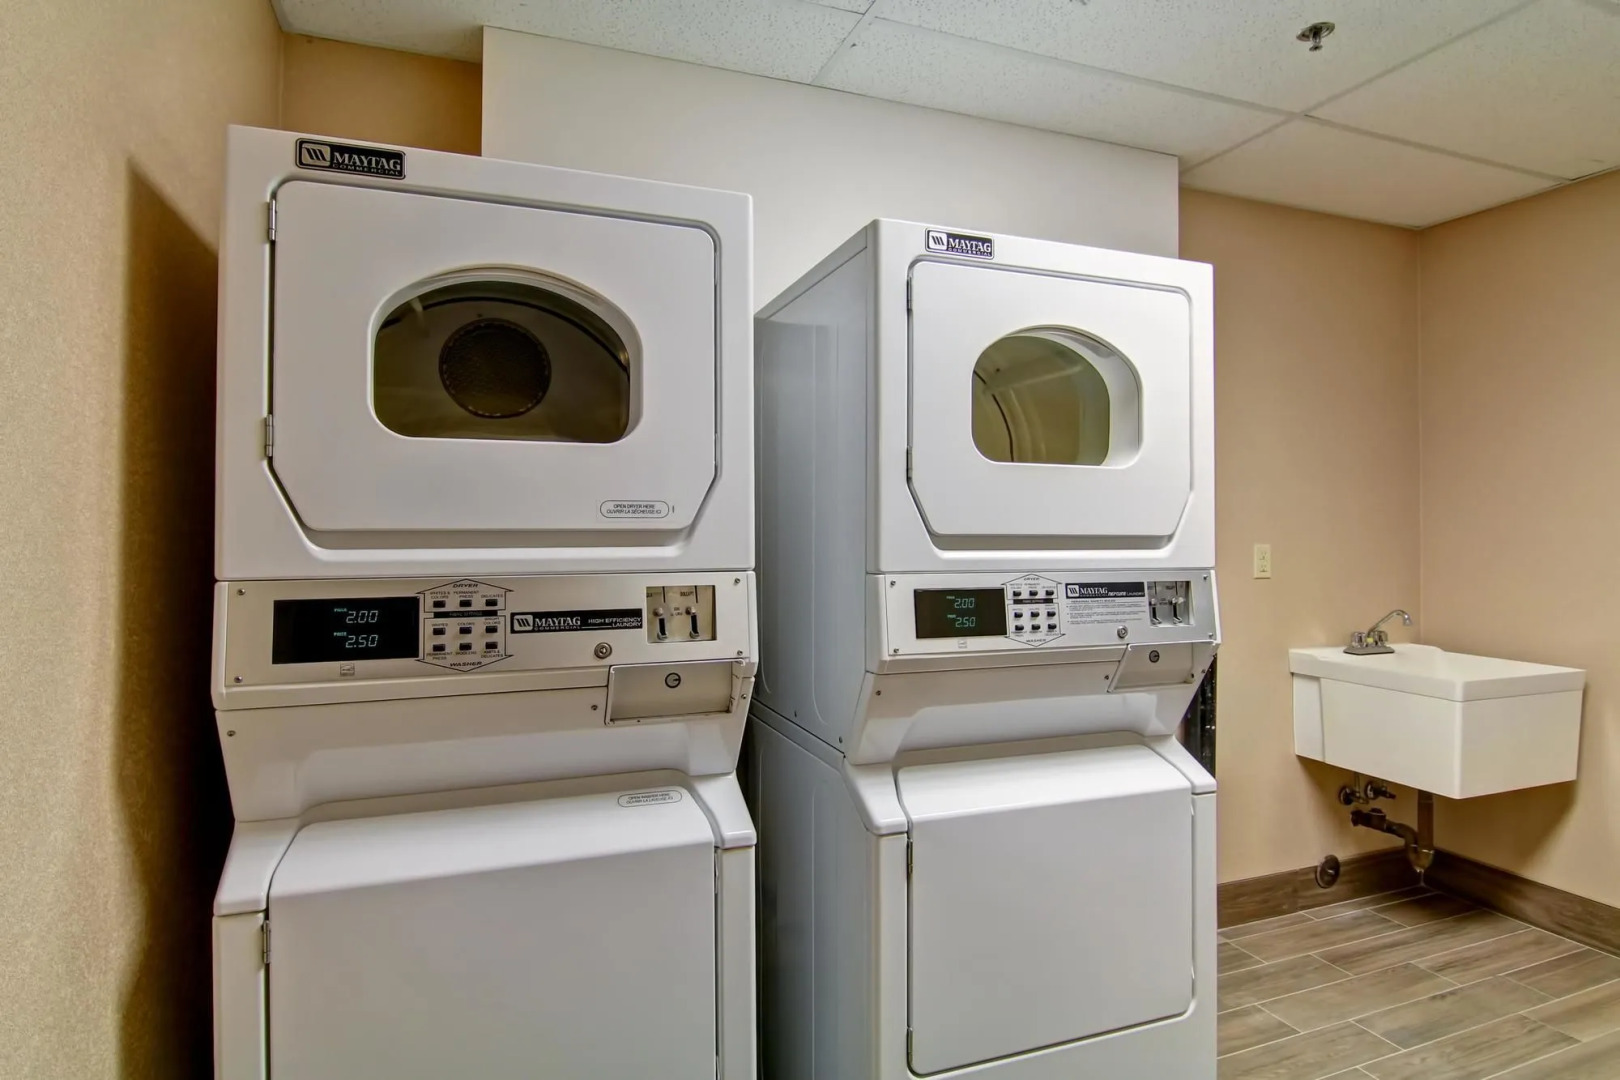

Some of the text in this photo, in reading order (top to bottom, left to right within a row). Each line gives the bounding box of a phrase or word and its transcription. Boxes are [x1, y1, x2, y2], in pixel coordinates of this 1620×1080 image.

[333, 151, 401, 171] MAYTAG
[332, 163, 401, 176] COMMERCIAL
[948, 238, 991, 253] MAYTAG
[954, 598, 975, 609] 2.00
[346, 610, 379, 624] 2.00
[534, 616, 581, 627] MAYTAG
[955, 616, 976, 628] 2.50
[345, 634, 379, 648] 2.50
